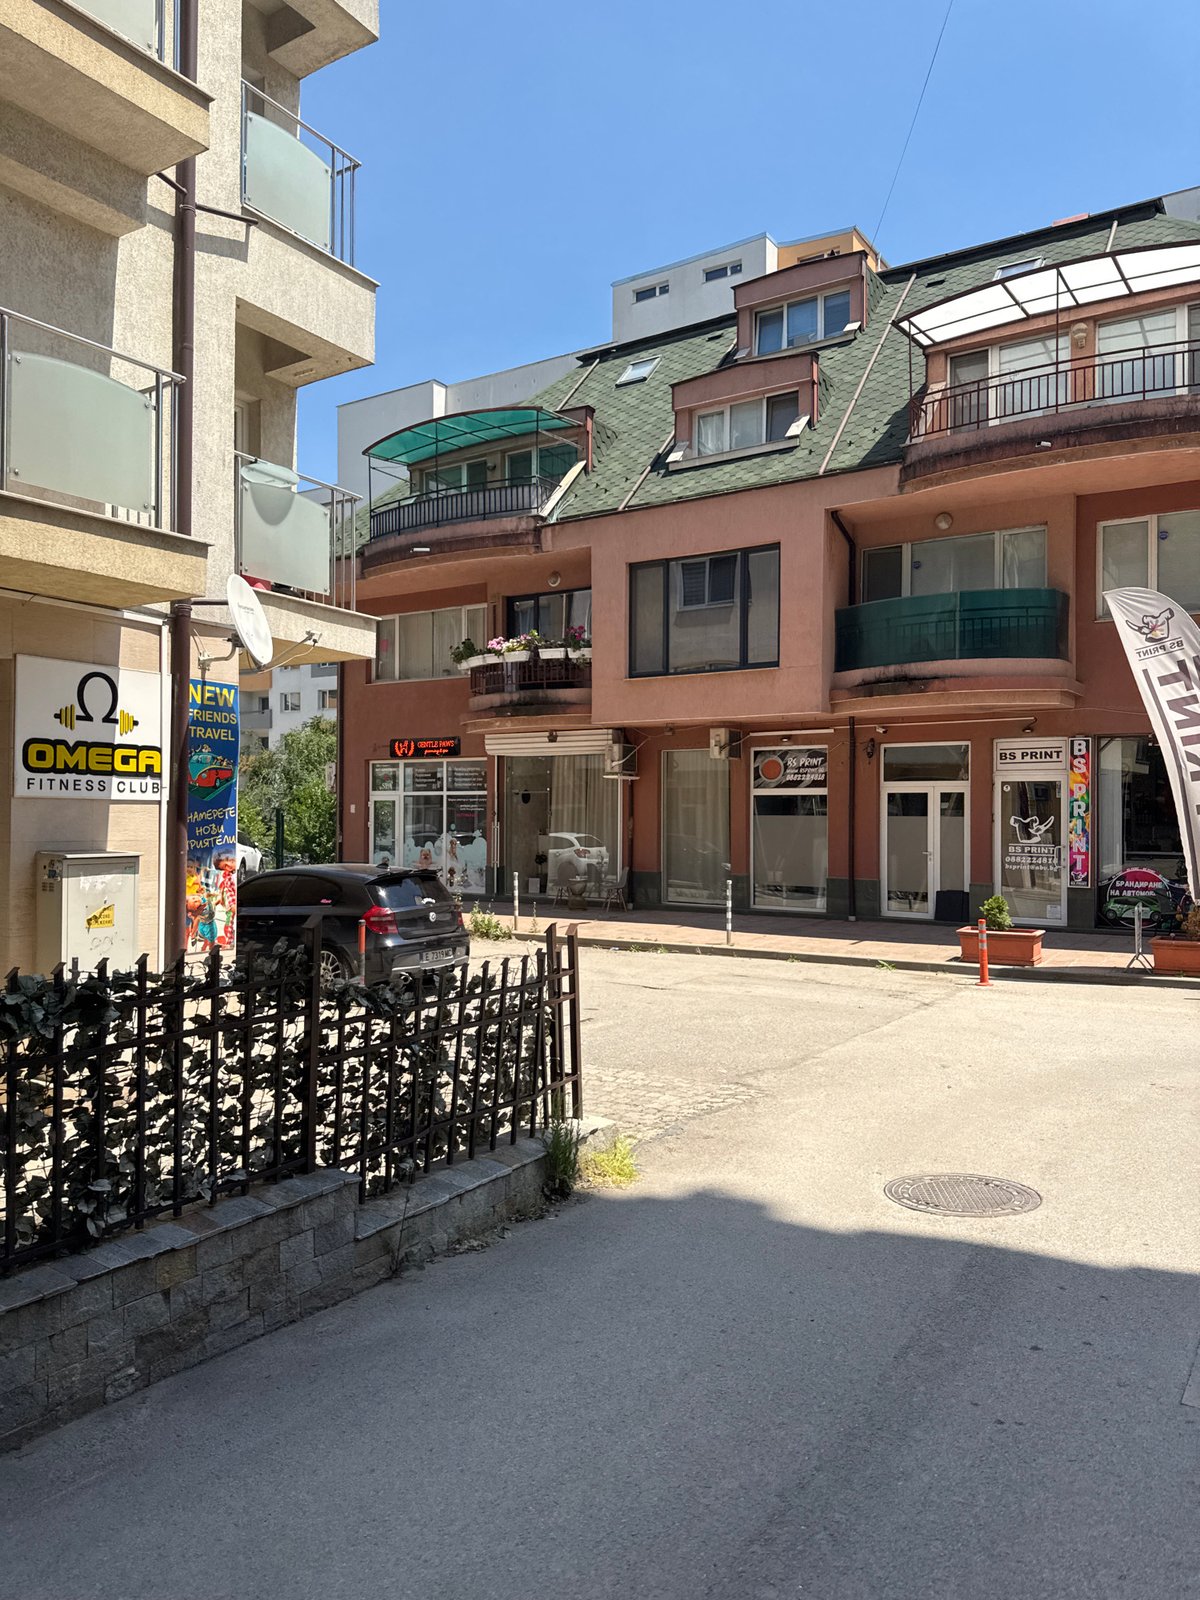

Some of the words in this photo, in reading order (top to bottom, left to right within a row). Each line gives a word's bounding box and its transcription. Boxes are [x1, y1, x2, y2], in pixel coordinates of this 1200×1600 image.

[189, 682, 235, 708] NEW
[189, 725, 236, 742] TRAVEL
[26, 742, 161, 775] OMEGA
[799, 757, 824, 767] PRINT
[999, 752, 1017, 761] BS
[1021, 750, 1062, 760] PRINT
[1073, 740, 1087, 773] BS
[27, 778, 107, 792] FITNESS
[117, 781, 160, 794] CLUB
[1073, 784, 1087, 870] PRINT
[187, 835, 237, 849] РИЯТЕЛИ
[1024, 846, 1055, 854] PRINT
